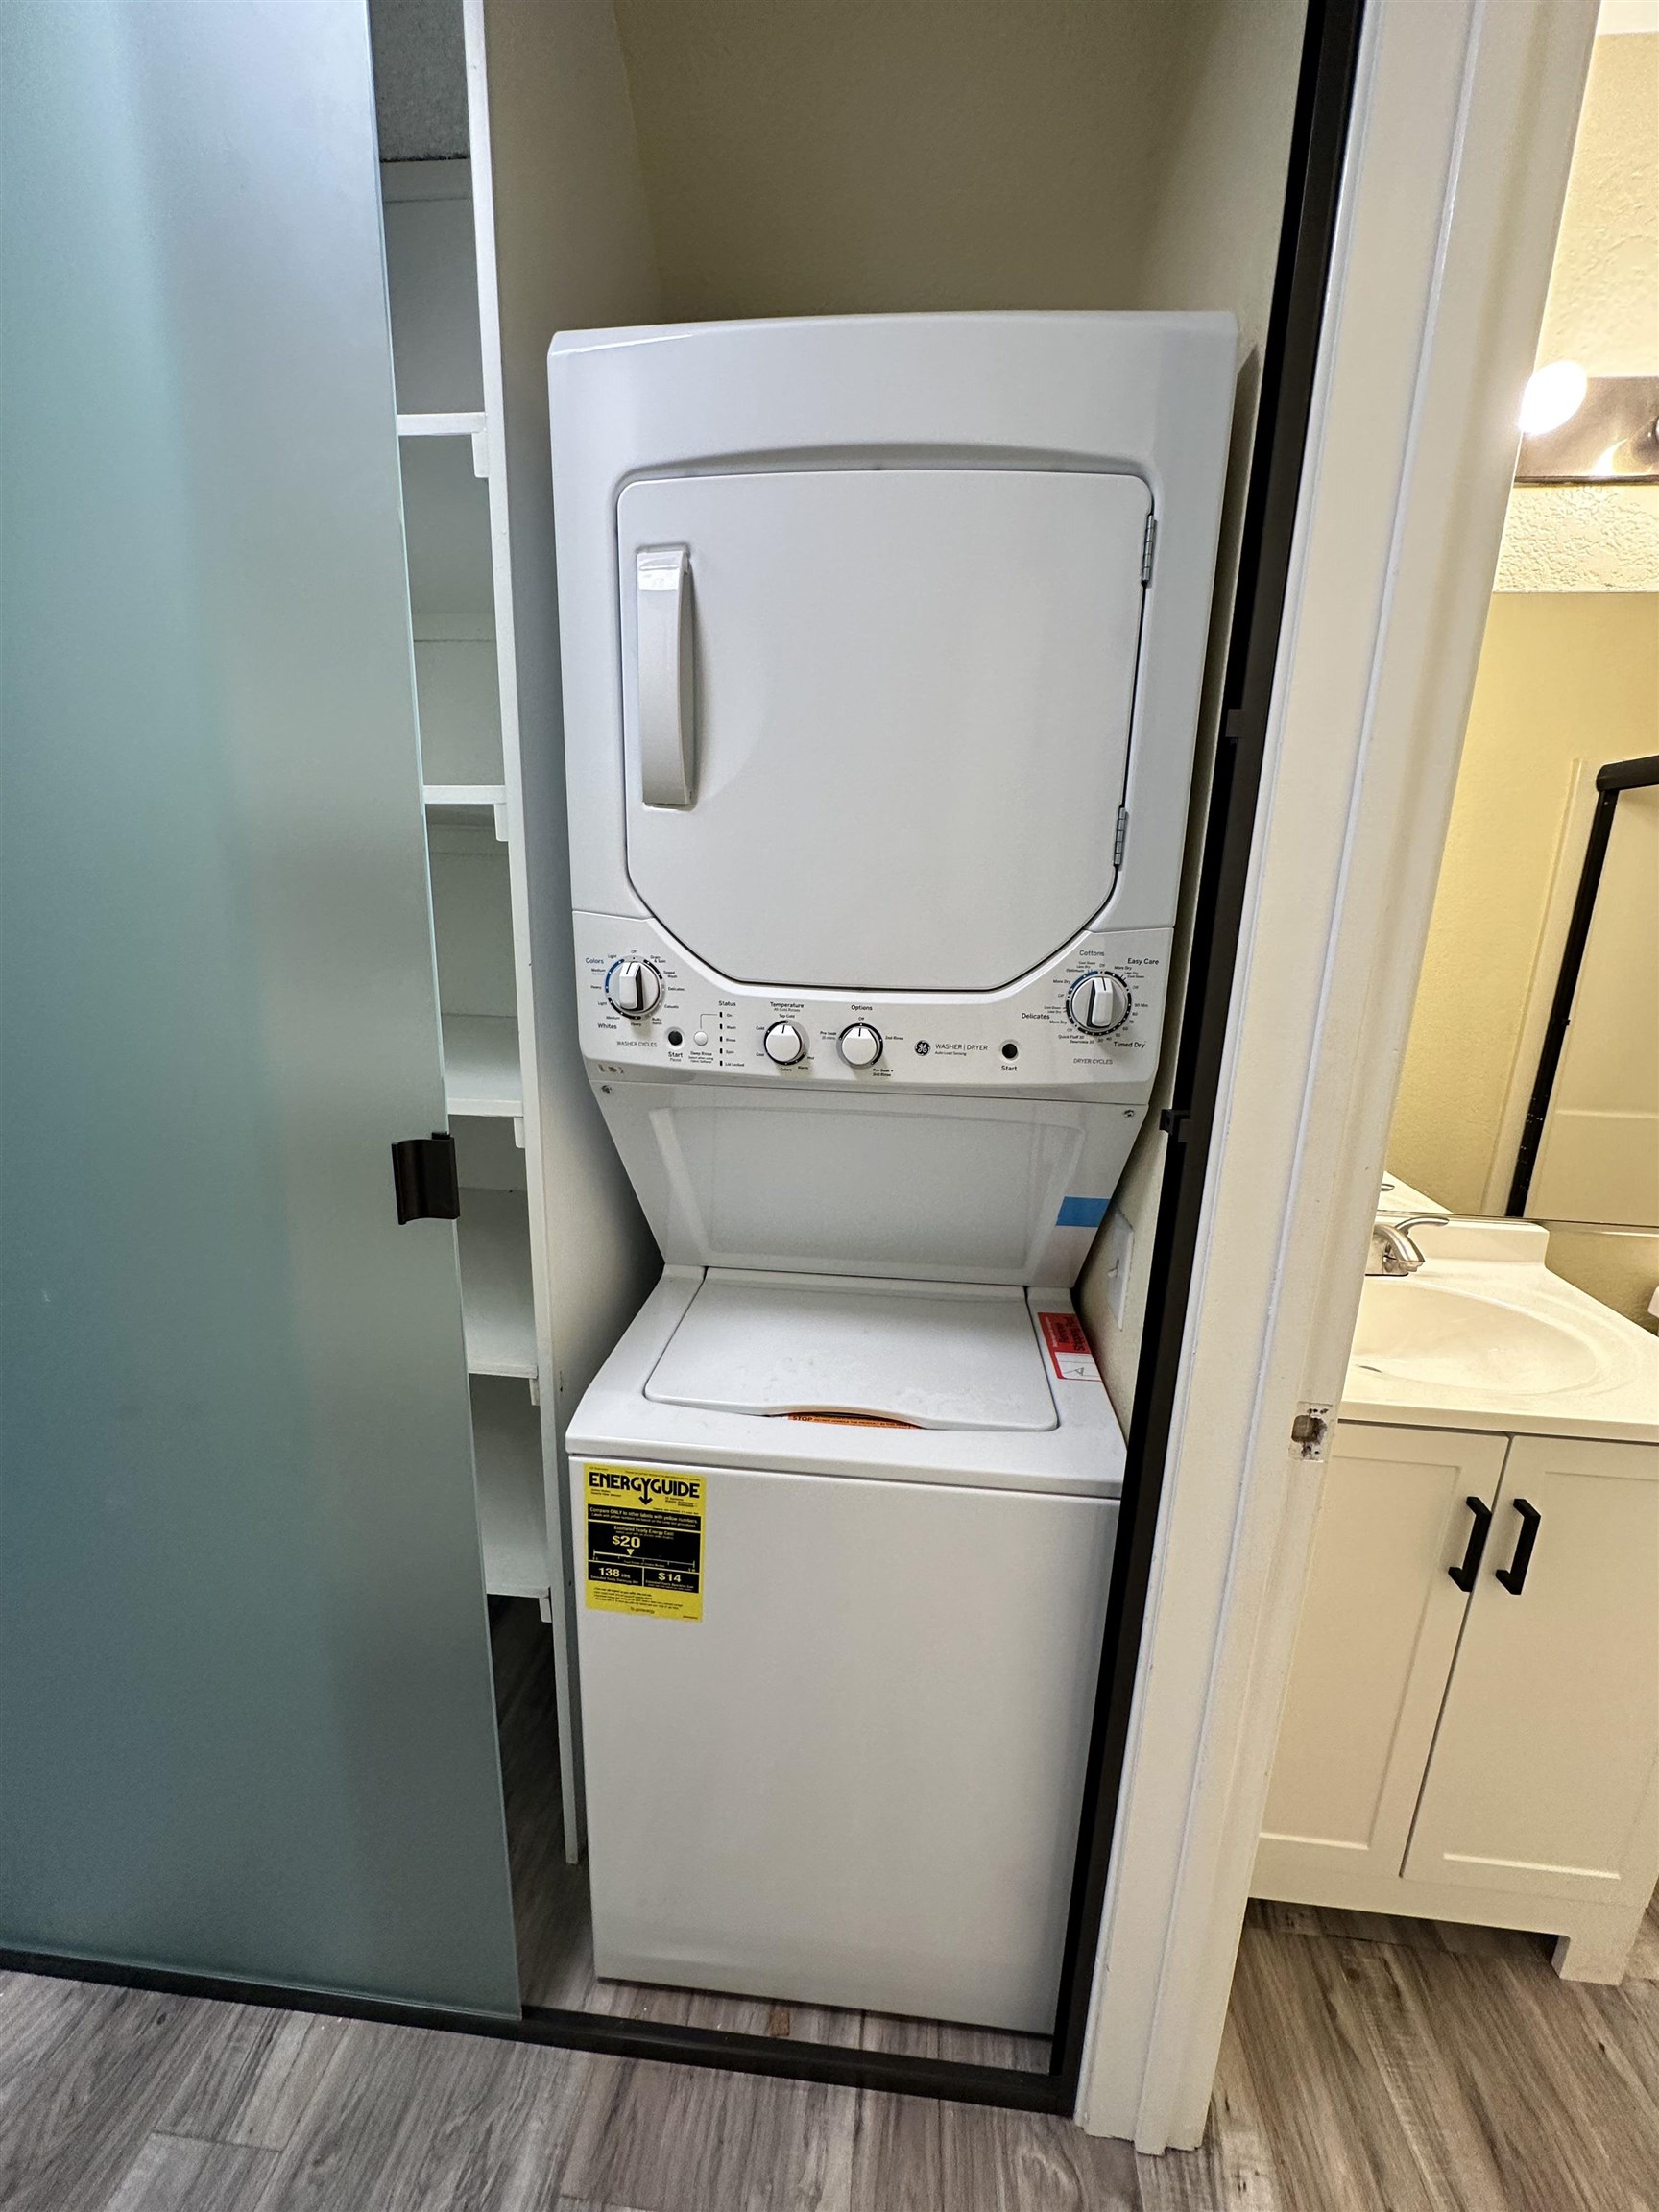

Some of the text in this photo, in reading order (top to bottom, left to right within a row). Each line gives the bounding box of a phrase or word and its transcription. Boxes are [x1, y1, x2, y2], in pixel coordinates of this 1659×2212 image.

[1134, 1041, 1146, 1049] Dry
[589, 1472, 700, 1499] ENERGYGUIDE
[612, 1535, 641, 1549] $20
[598, 1567, 620, 1577] 138
[658, 1572, 682, 1583] $14
